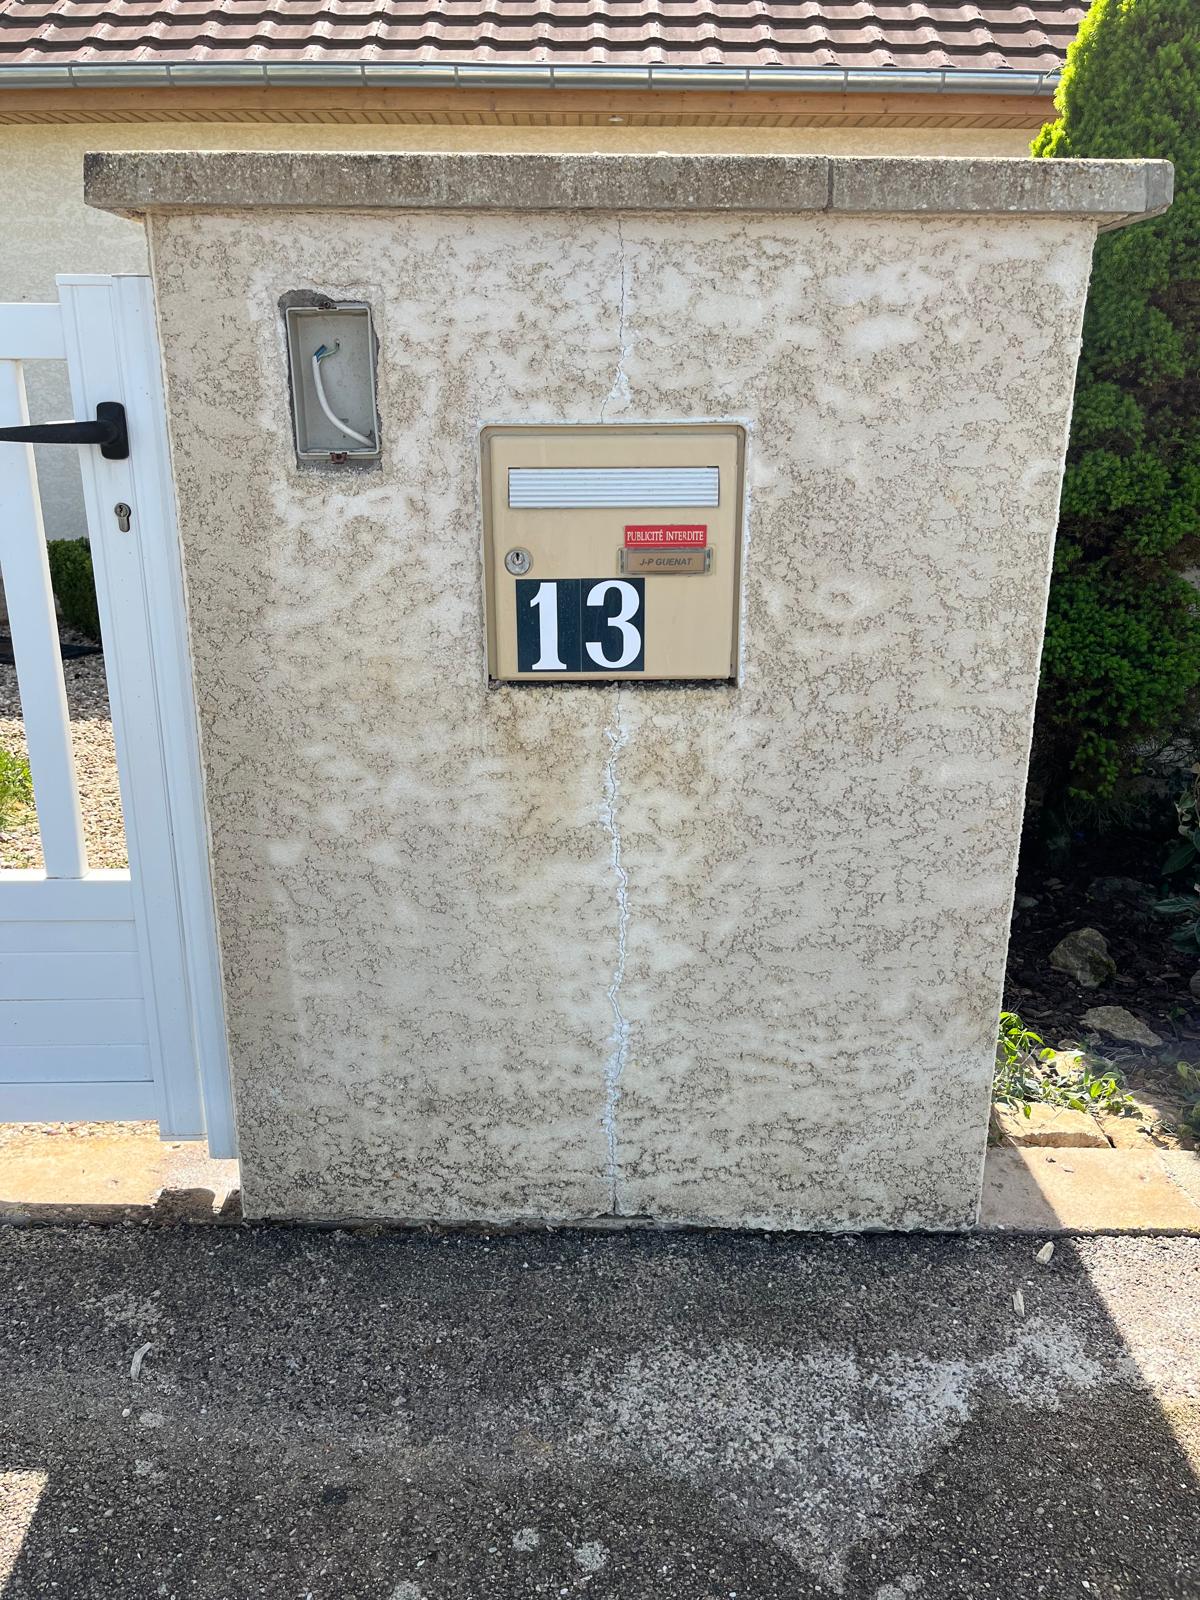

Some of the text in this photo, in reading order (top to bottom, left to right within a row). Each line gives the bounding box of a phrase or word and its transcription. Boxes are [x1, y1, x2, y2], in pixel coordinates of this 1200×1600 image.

[626, 529, 704, 541] PUBLICITÉ INTERDITE
[639, 558, 693, 566] J-P GUENAT
[529, 579, 642, 671] 13
